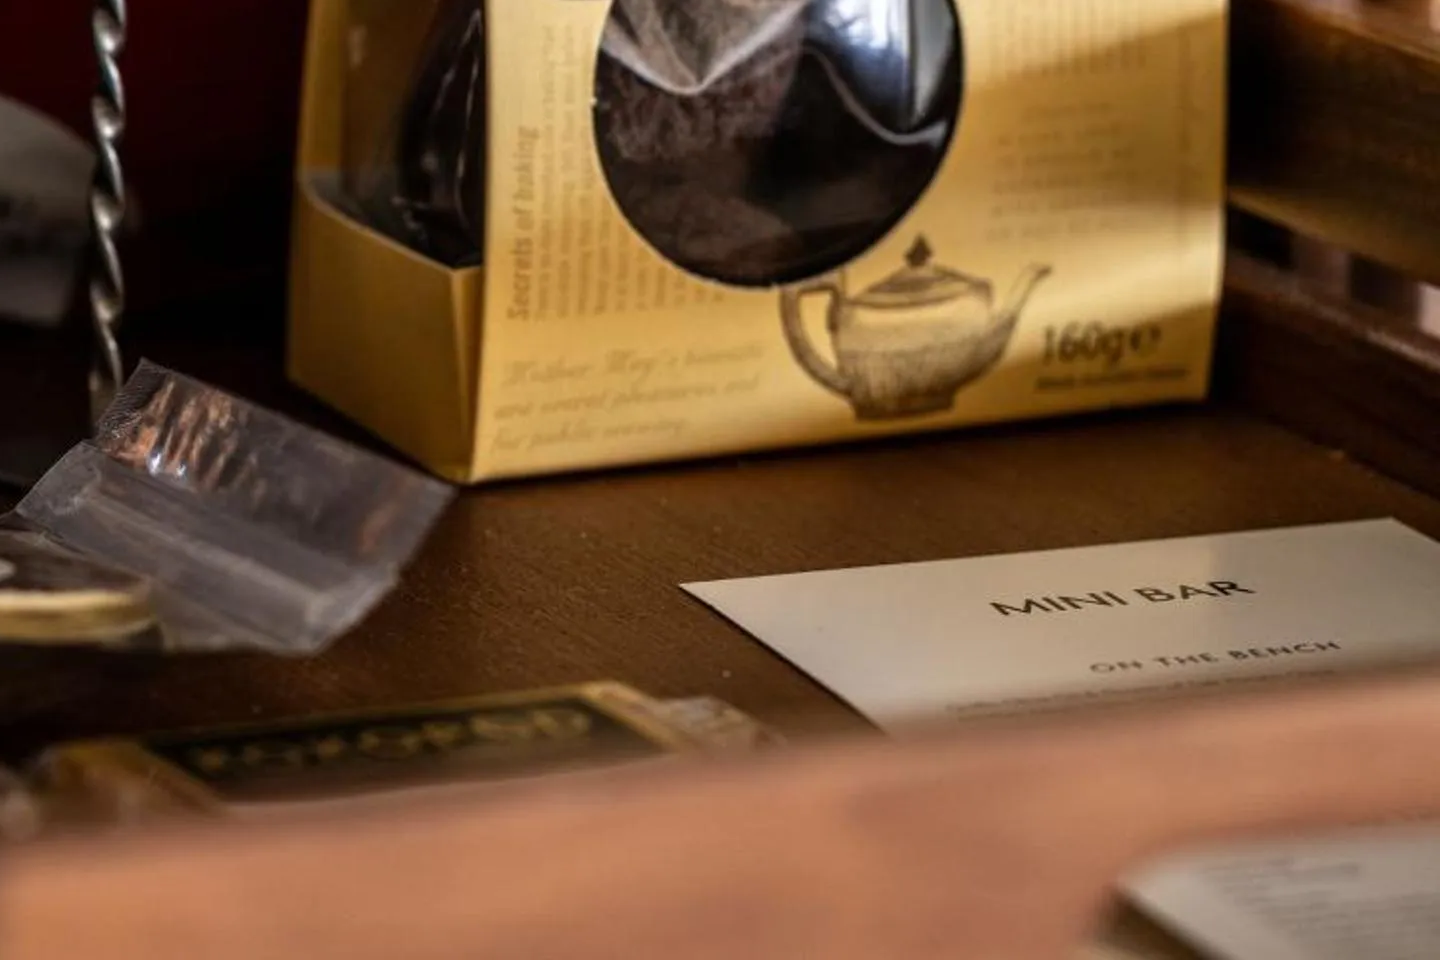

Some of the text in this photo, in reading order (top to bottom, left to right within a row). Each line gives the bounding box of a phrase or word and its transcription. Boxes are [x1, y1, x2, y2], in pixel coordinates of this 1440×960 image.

[990, 580, 1258, 616] MINI BAR
[1089, 640, 1343, 674] ON THE BENCH
